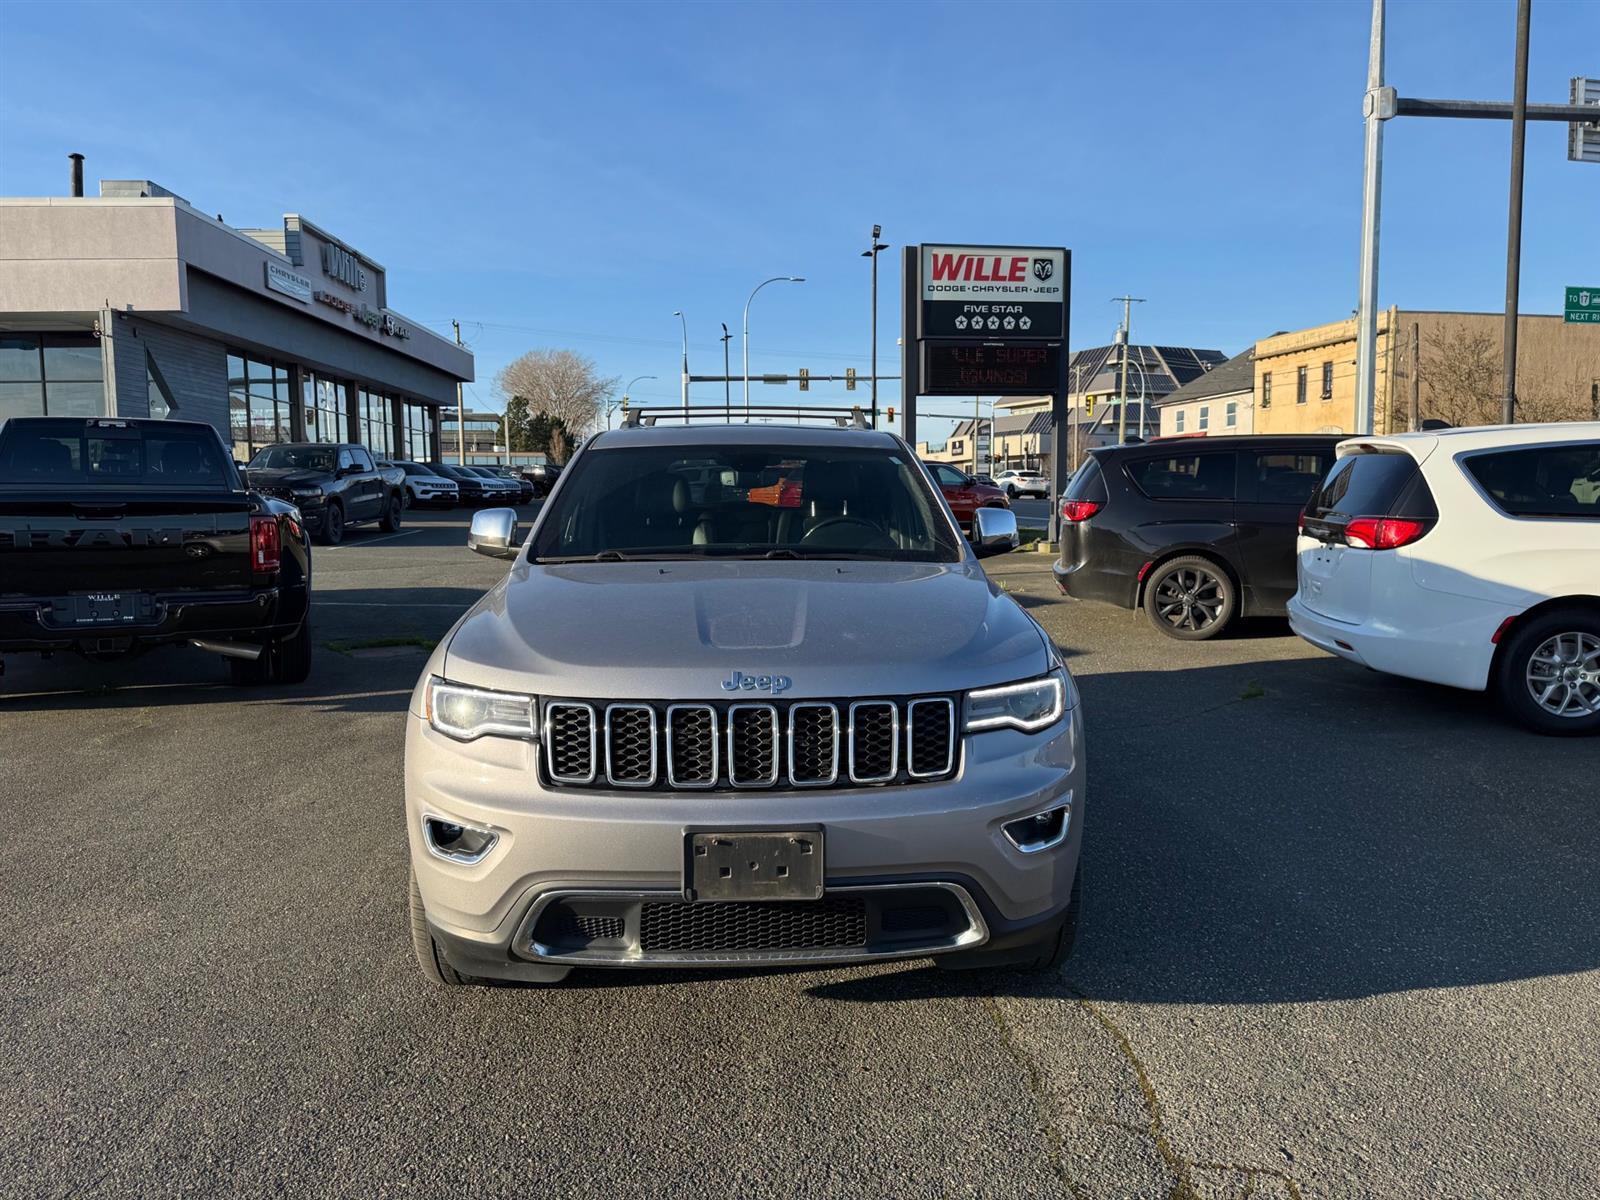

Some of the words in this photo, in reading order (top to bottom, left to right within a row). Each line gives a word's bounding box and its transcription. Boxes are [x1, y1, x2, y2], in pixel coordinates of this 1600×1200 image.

[270, 266, 310, 289] CHRYSLER
[932, 254, 1029, 282] WILLE
[972, 285, 1027, 293] CHRYSLER
[964, 305, 989, 313] FIVE
[991, 305, 1023, 313] STAR
[1592, 313, 1600, 321] RI
[14, 528, 183, 547] RAM
[720, 671, 791, 694] Jeep
